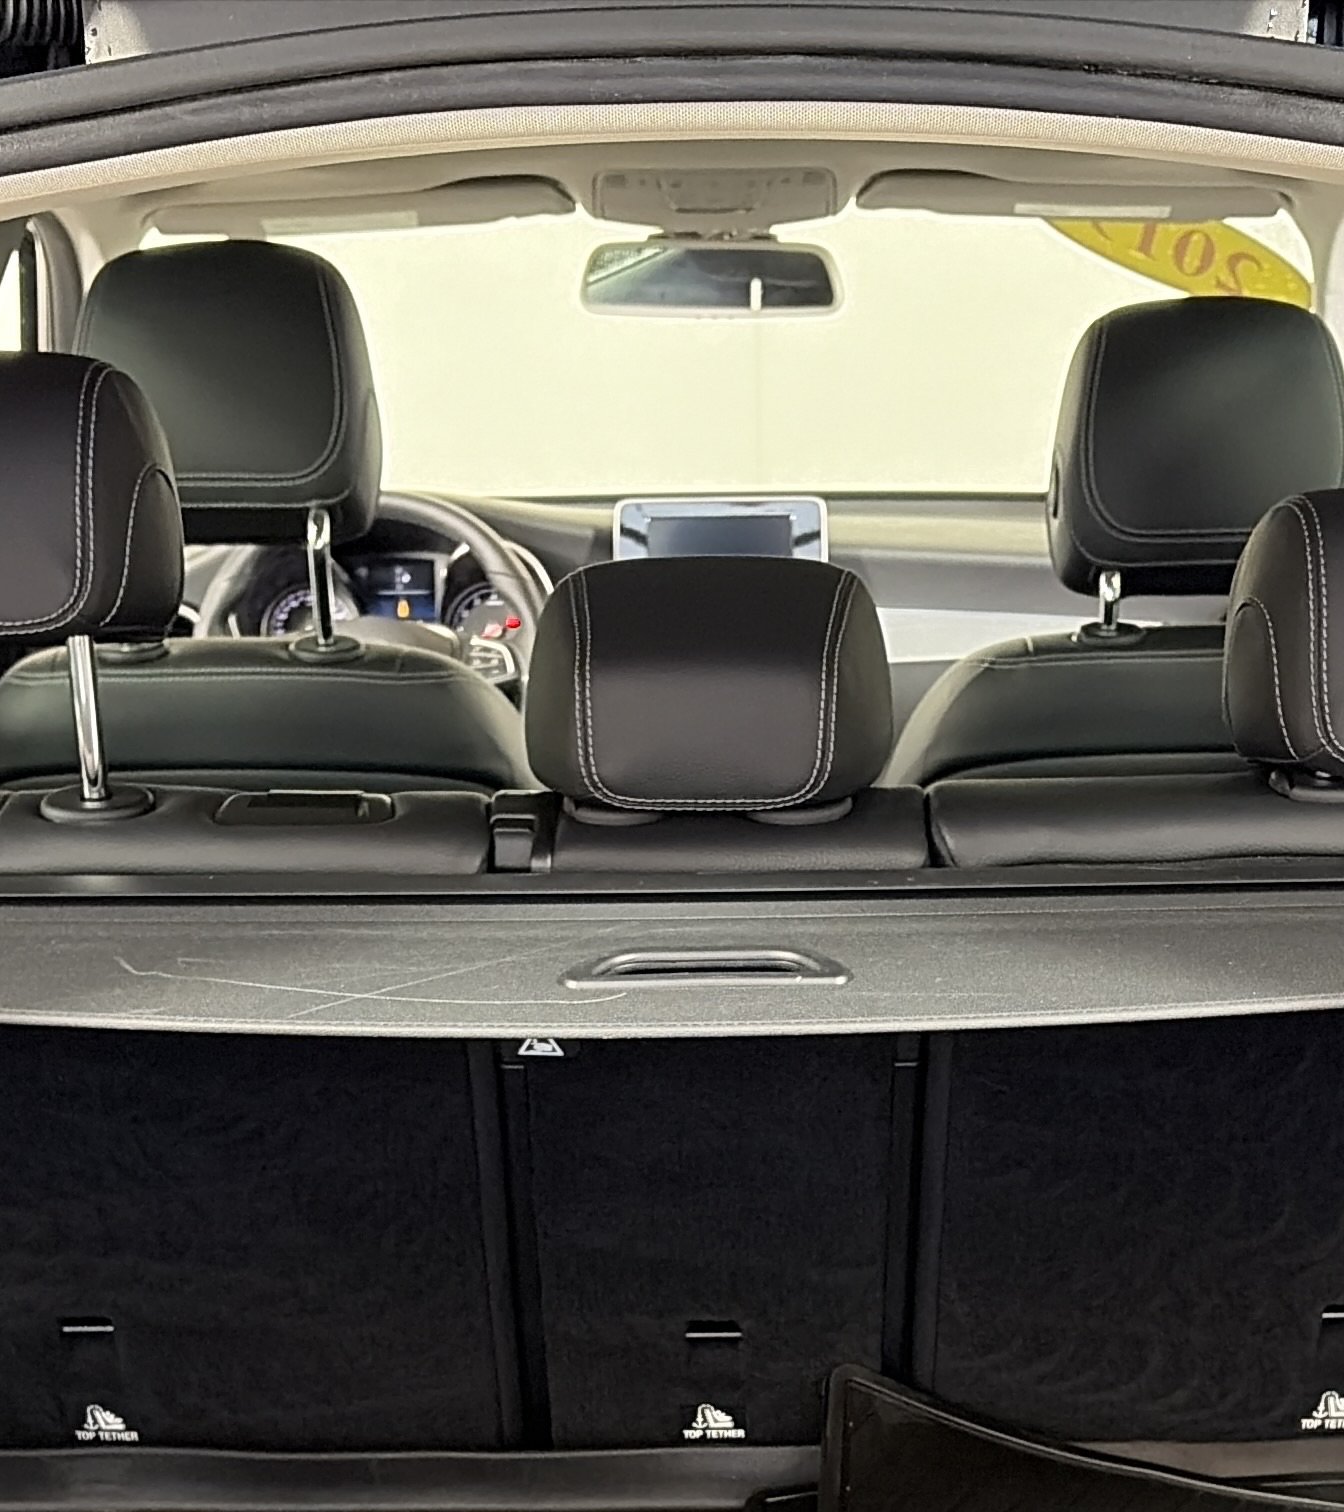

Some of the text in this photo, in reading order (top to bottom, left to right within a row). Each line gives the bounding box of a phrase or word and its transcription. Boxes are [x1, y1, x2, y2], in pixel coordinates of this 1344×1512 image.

[1300, 1418, 1323, 1430] TOP
[75, 1430, 139, 1442] TOP TETHER
[682, 1429, 746, 1439] TOP TETHER
